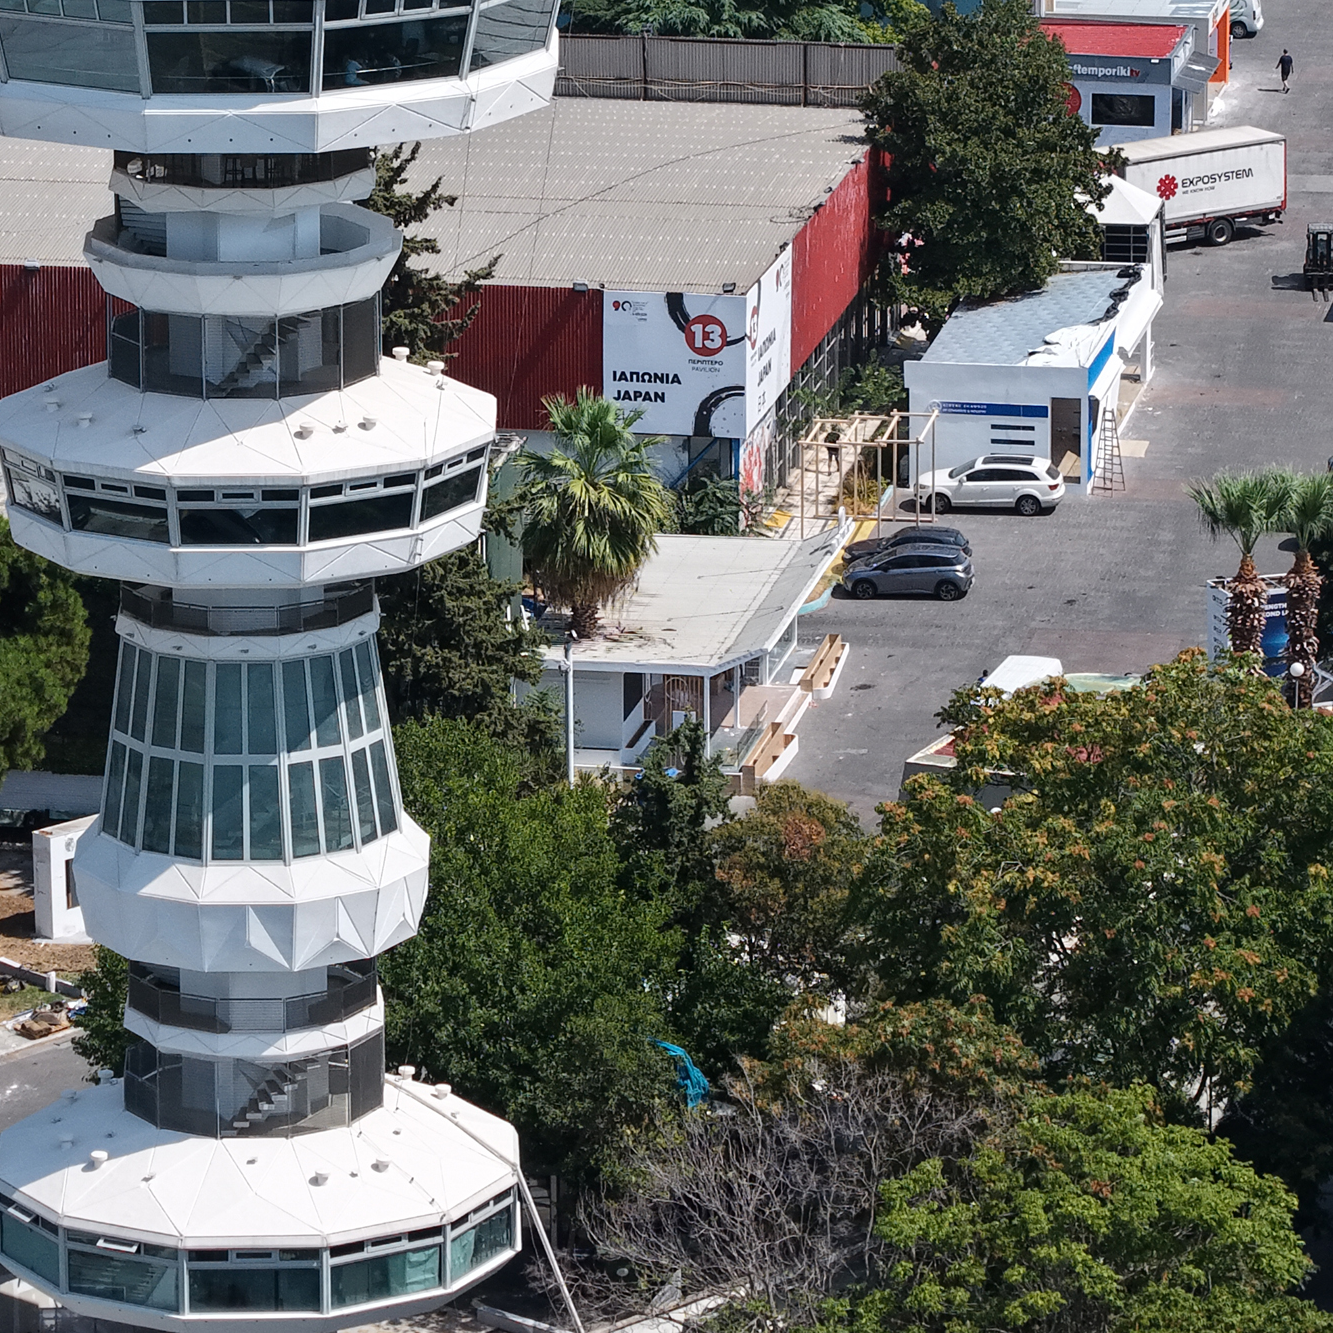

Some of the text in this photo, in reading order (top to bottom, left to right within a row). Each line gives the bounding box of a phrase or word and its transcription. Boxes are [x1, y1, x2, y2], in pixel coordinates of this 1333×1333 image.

[1182, 168, 1253, 188] EXPOSYSTEM
[691, 324, 722, 349] 13
[758, 328, 776, 361] ΙΑΠΩΝΙΑ
[613, 371, 681, 385] ΙΑΠΩΝΙΑ
[758, 357, 772, 387] JAPAN
[613, 390, 665, 403] JAPAN
[1262, 602, 1288, 611] ENGTH
